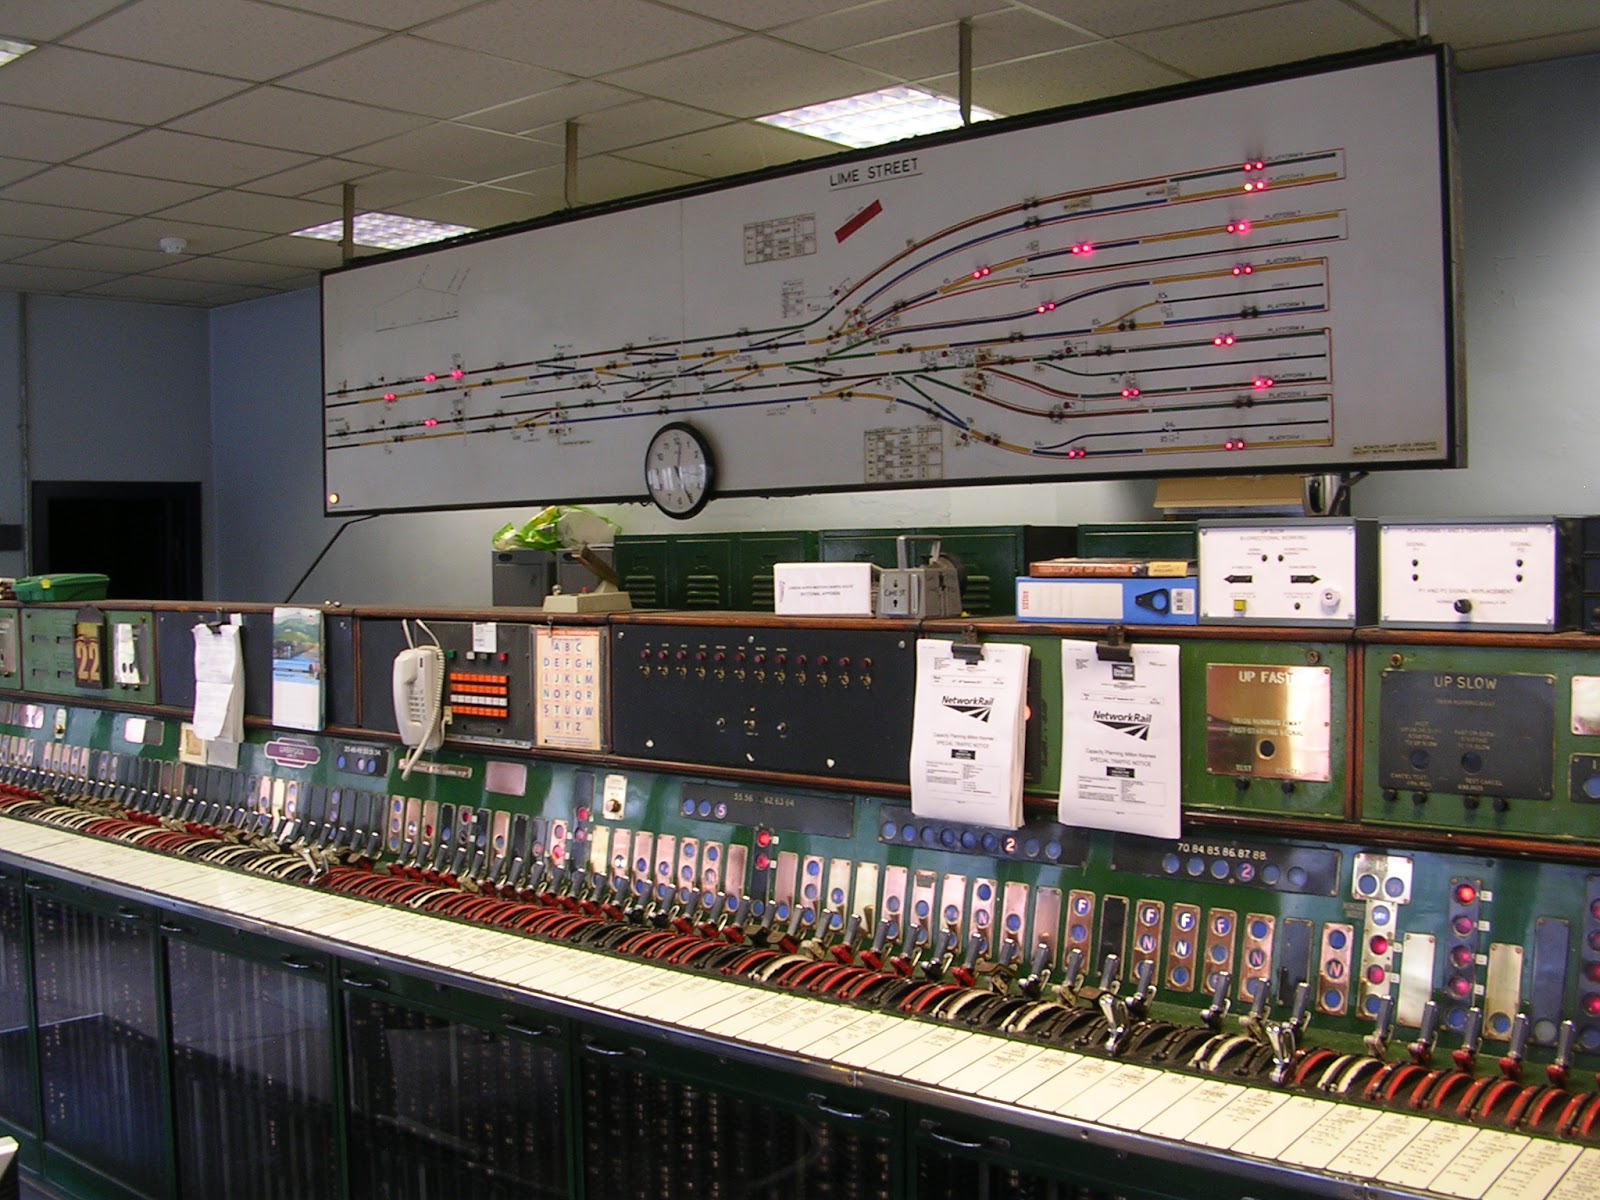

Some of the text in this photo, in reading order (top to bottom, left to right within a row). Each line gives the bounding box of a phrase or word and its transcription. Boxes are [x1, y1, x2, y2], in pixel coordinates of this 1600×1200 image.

[830, 158, 918, 186] LIME STREET
[554, 642, 581, 652] A B C
[76, 641, 100, 680] 22
[544, 658, 592, 668] D E F G H
[576, 676, 580, 684] L
[586, 676, 593, 684] M
[1239, 670, 1292, 684] UP FAST
[1434, 676, 1497, 690] UP SLOW
[554, 690, 560, 698] O
[565, 690, 569, 698] P
[575, 691, 581, 699] Q
[587, 691, 592, 699] R
[544, 705, 593, 716] S T U V W
[555, 721, 560, 729] X
[576, 723, 581, 731] Z
[719, 806, 725, 816] 5
[1006, 838, 1015, 852] 2
[1242, 863, 1250, 878] 2
[1078, 899, 1087, 912] F
[1146, 909, 1155, 922] F
[1181, 913, 1191, 928] F
[1217, 918, 1225, 933] F
[1143, 936, 1153, 950] N
[1177, 941, 1187, 955] N
[1252, 951, 1263, 965] N
[1330, 961, 1342, 977] N
